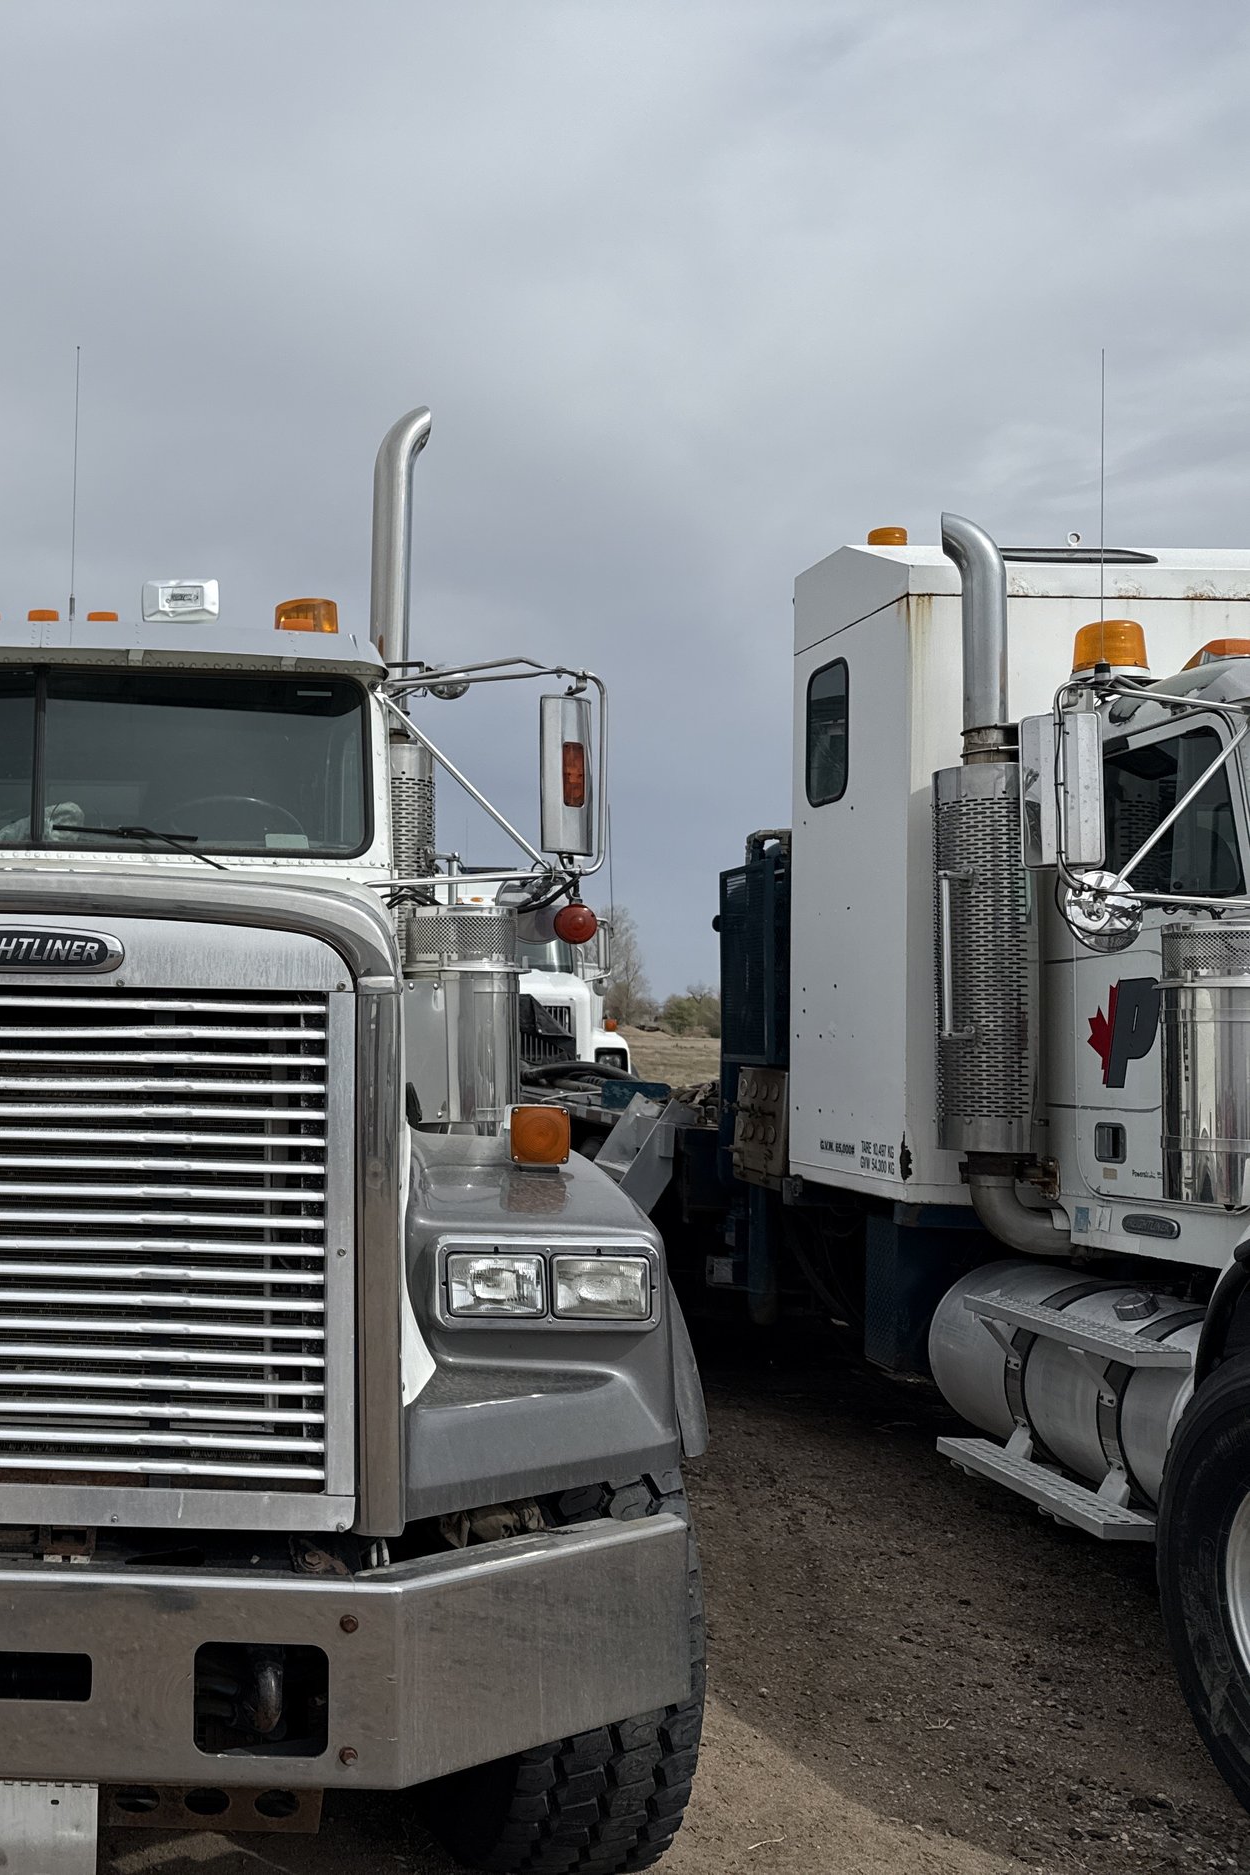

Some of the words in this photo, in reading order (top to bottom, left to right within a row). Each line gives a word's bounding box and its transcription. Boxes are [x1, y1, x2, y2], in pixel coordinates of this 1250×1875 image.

[1106, 977, 1160, 1088] P
[861, 1140, 871, 1154] TARE
[888, 1145, 894, 1159] KG
[860, 1156, 870, 1169] GVW
[871, 1158, 887, 1173] 54,300
[888, 1161, 894, 1175] KG
